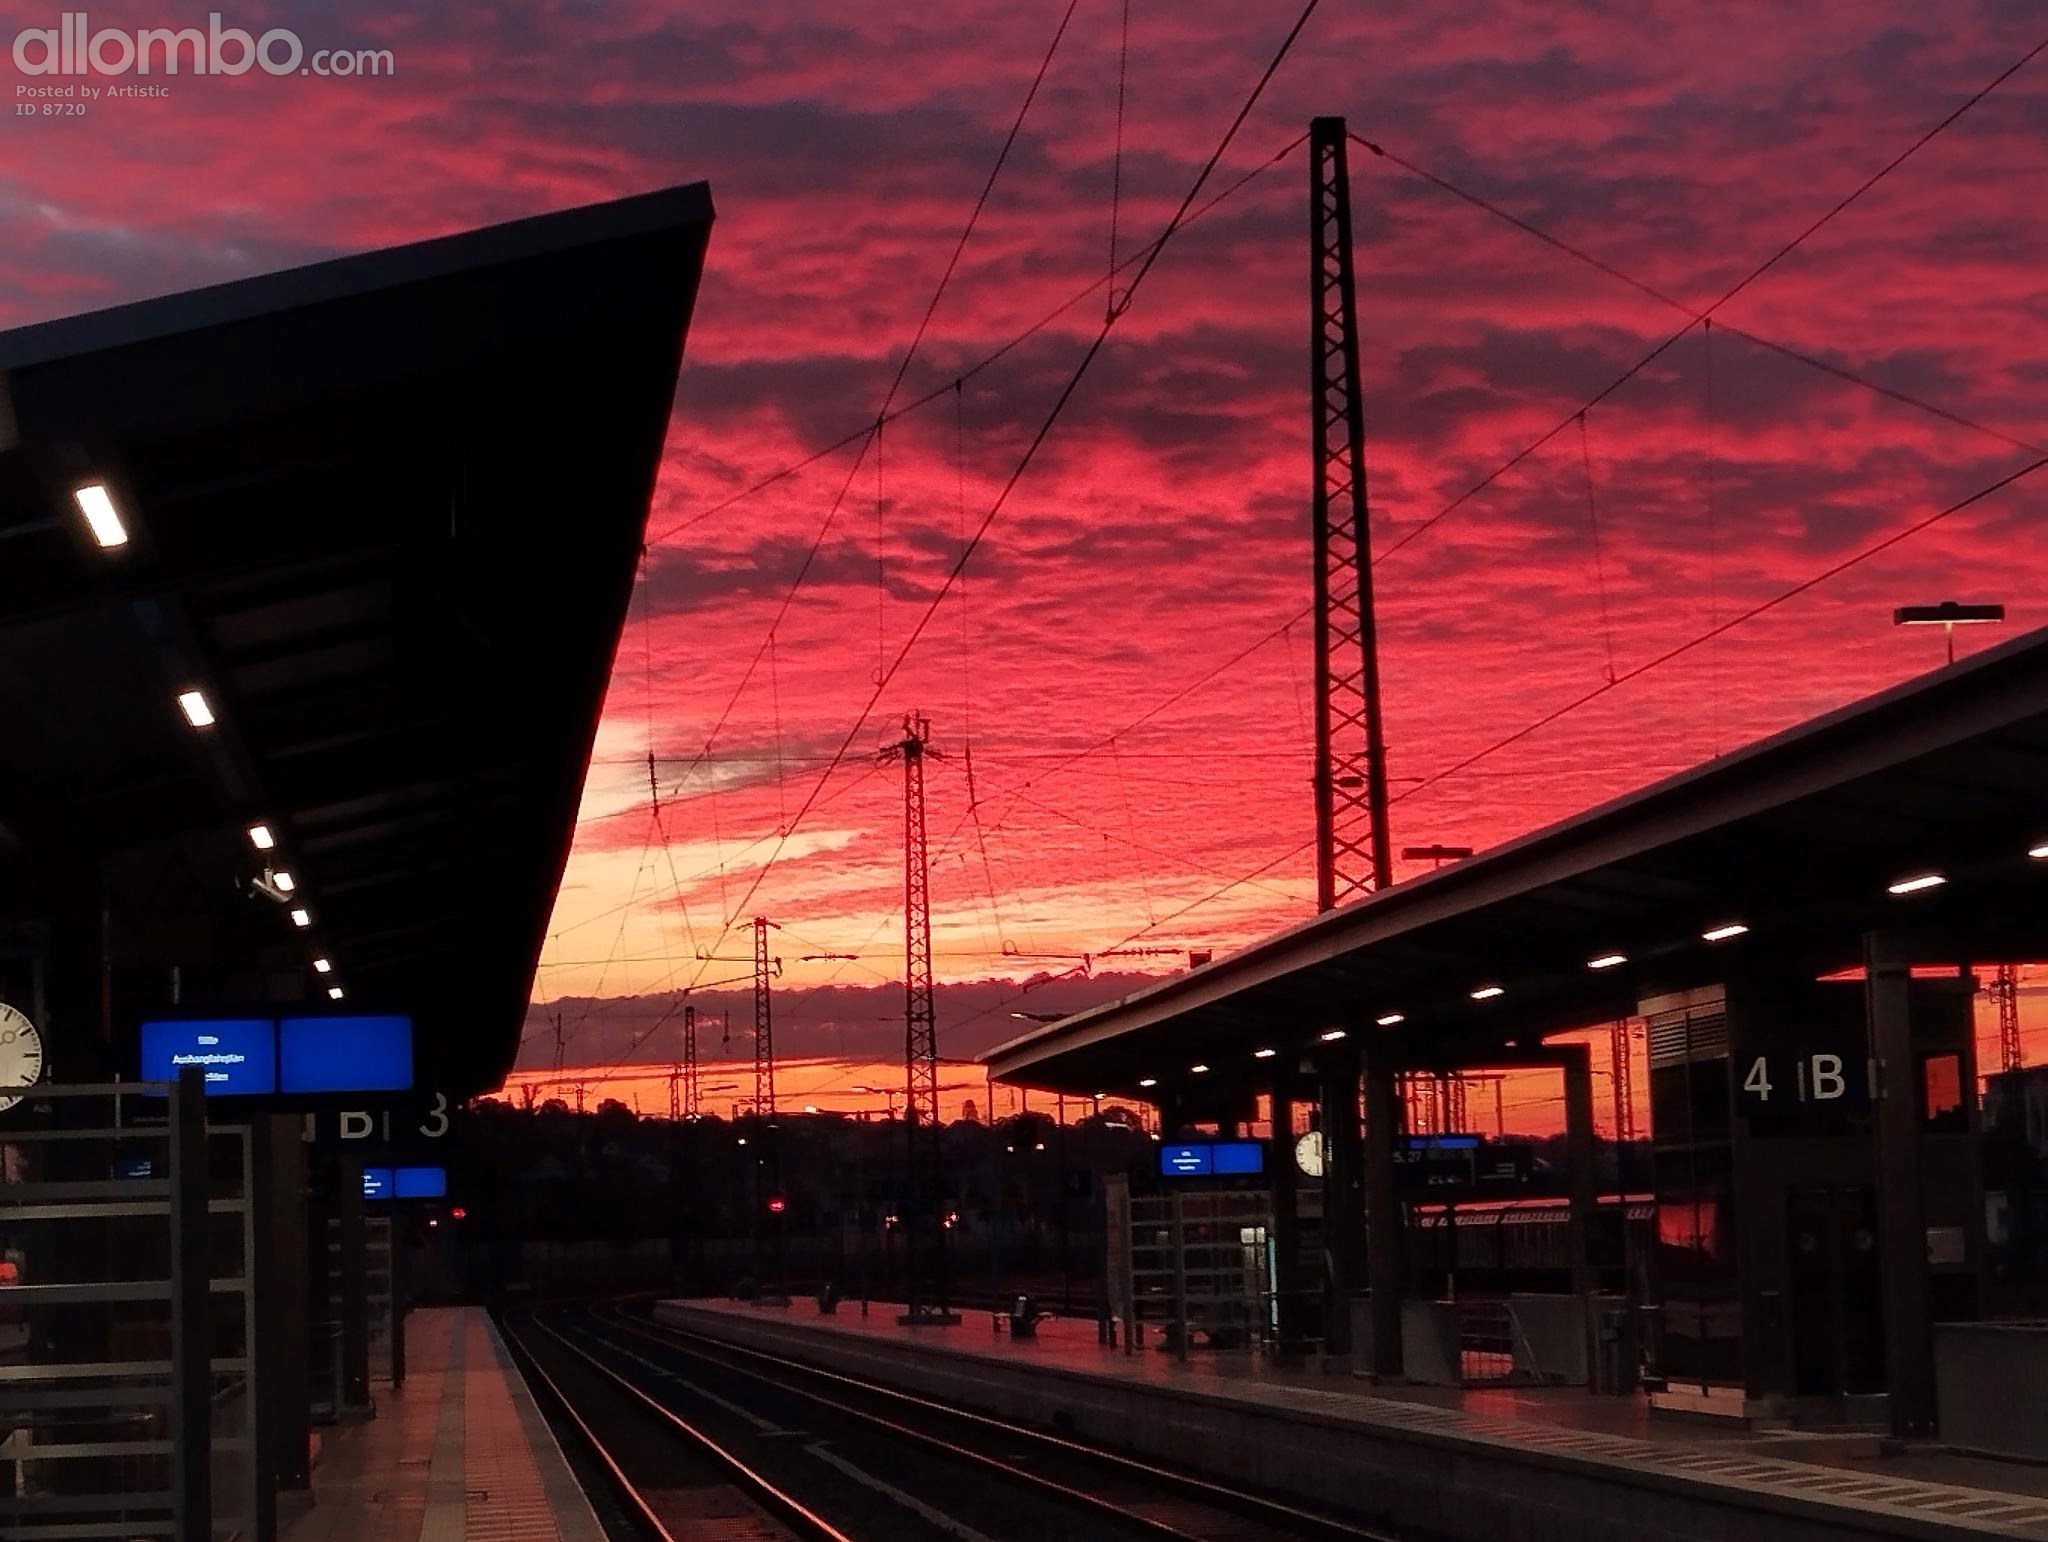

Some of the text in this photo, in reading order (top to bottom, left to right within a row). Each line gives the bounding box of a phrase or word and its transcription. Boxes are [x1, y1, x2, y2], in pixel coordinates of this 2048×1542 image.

[1743, 1054, 1846, 1101] 4 B
[419, 1092, 449, 1137] 3
